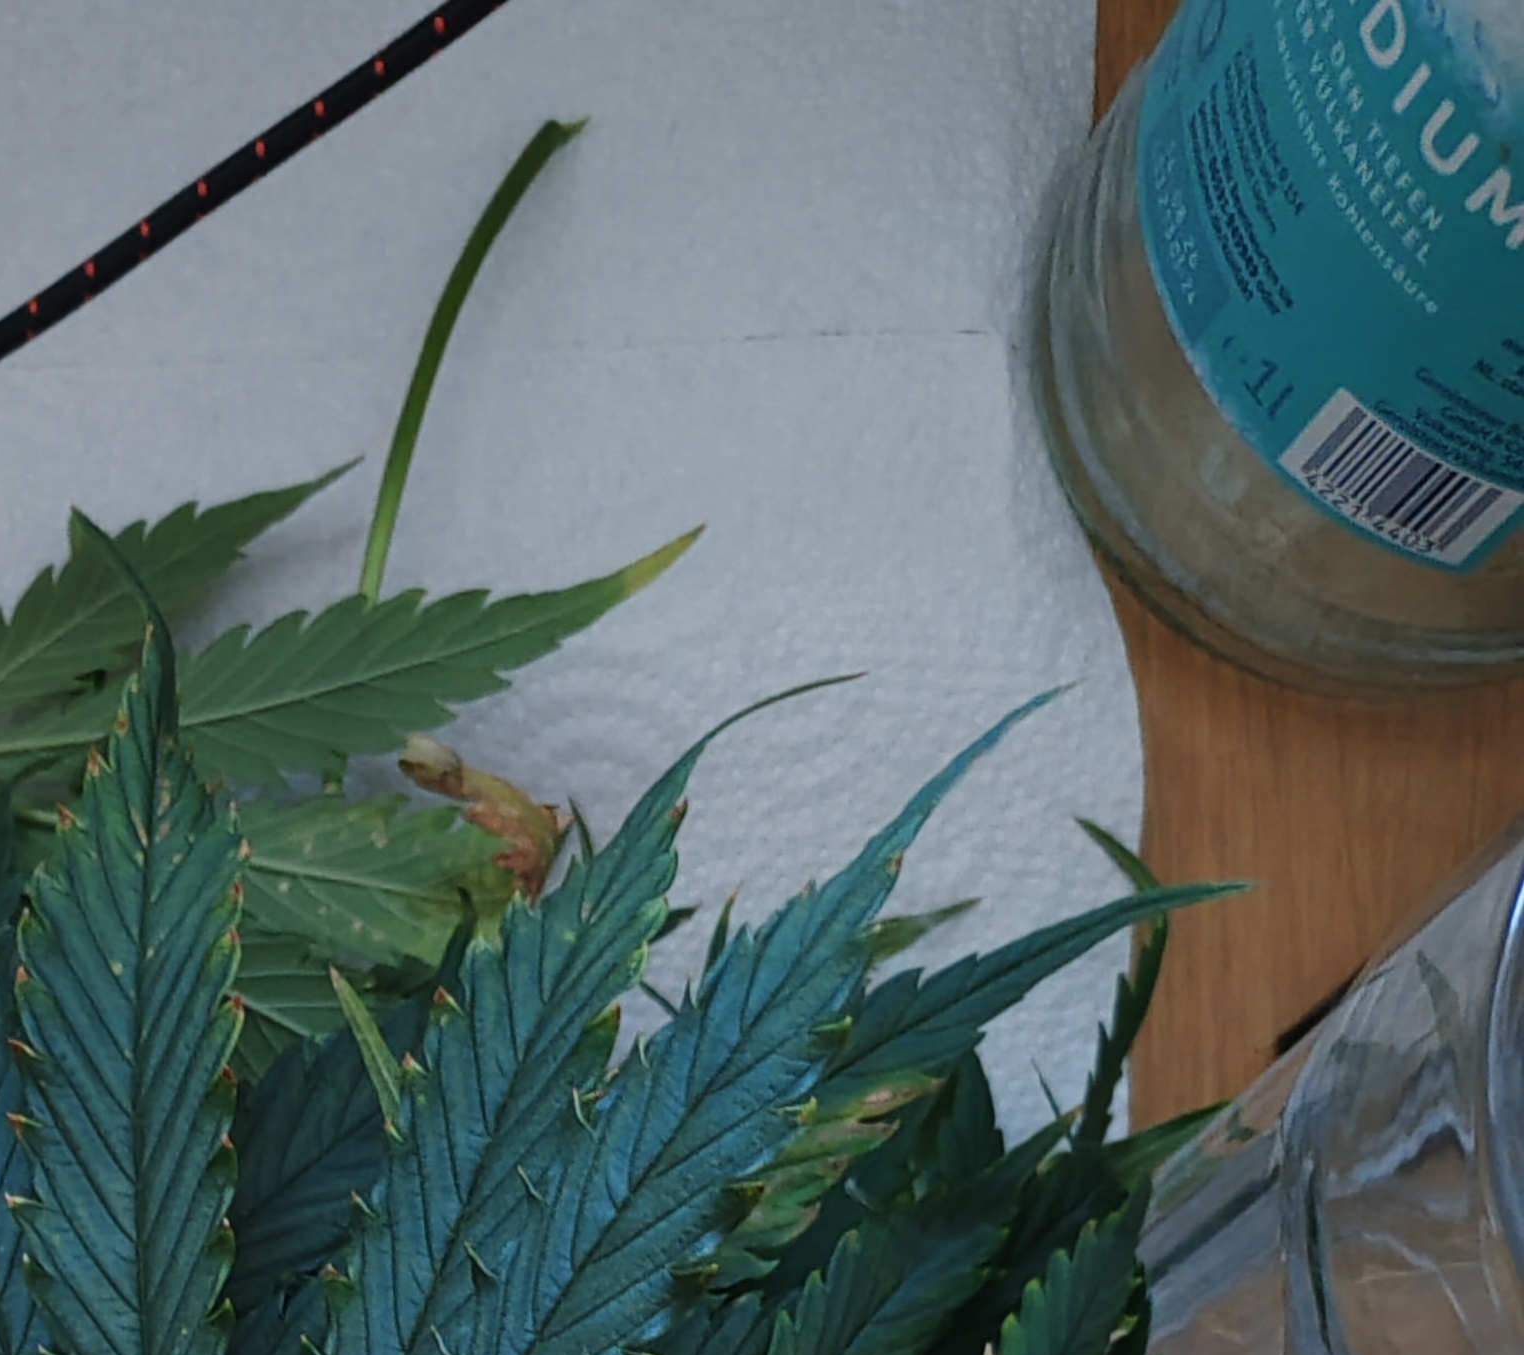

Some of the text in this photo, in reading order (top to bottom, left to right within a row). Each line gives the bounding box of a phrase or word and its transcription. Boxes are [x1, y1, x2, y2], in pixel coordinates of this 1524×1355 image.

[1310, 50, 1430, 266] VULKANEIFEL
[1331, 39, 1444, 231] DEN TIEFEN
